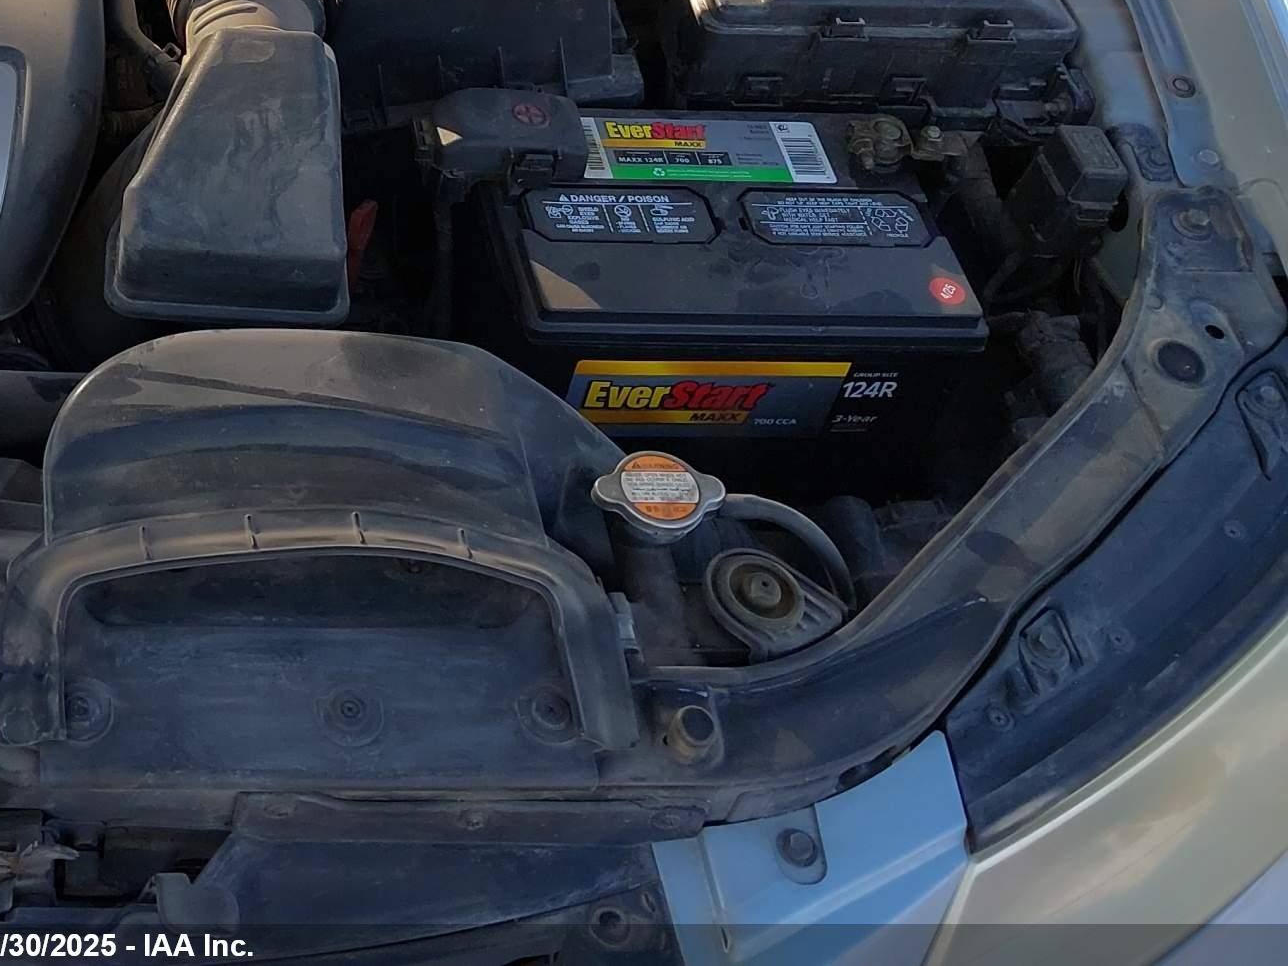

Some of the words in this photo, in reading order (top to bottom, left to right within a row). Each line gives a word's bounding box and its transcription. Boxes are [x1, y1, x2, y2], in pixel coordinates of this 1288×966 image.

[604, 121, 705, 140] EverStart
[570, 194, 617, 202] DANGER
[627, 195, 670, 203] POISON
[583, 380, 770, 410] EverStart
[842, 381, 898, 398] 124R
[688, 411, 743, 422] MAXX
